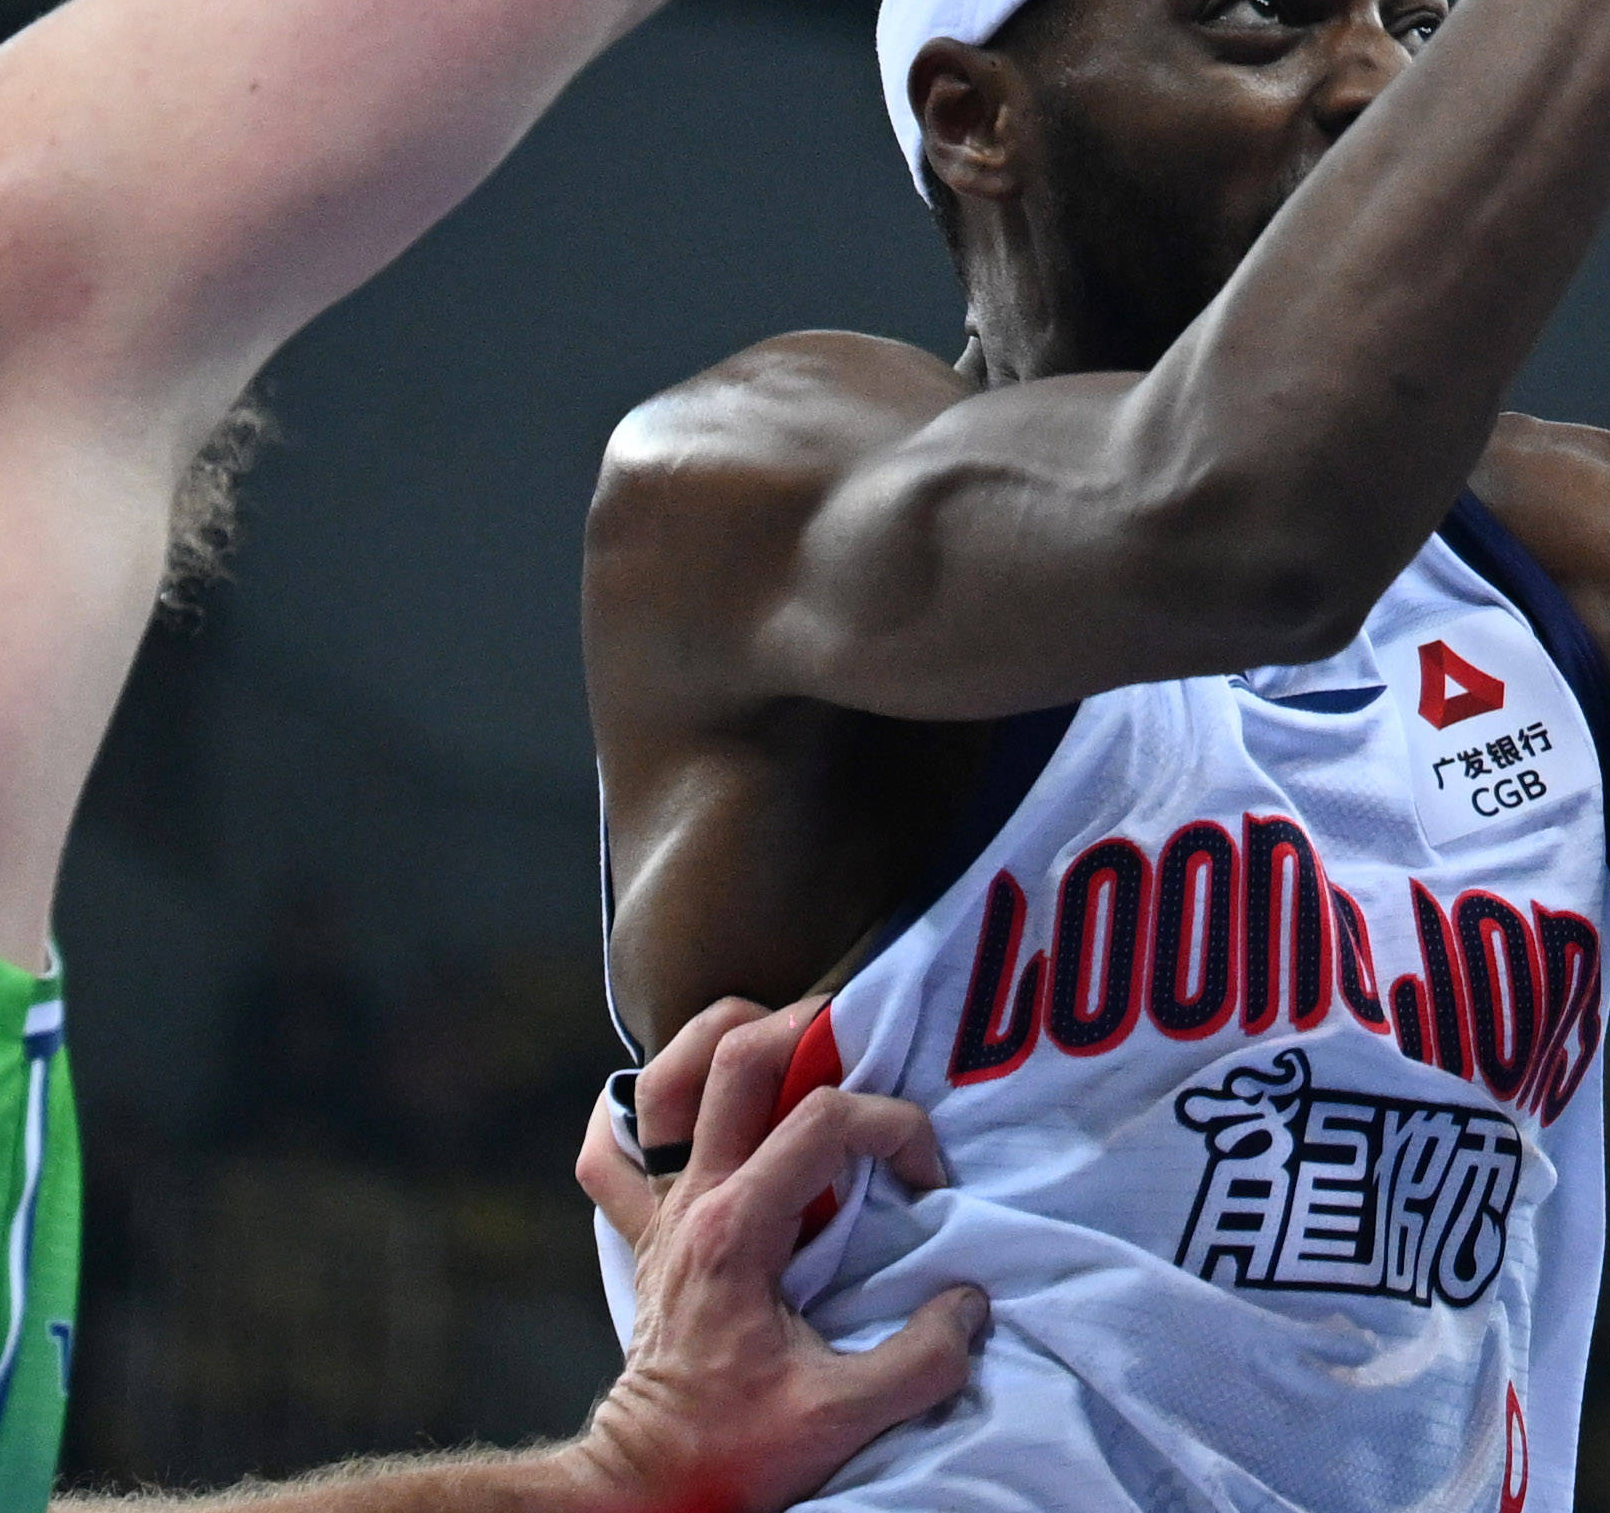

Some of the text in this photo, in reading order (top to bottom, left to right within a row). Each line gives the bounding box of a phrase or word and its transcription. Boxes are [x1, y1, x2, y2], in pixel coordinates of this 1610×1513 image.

[1432, 721, 1553, 790] 广发银行
[1471, 769, 1547, 817] CGB
